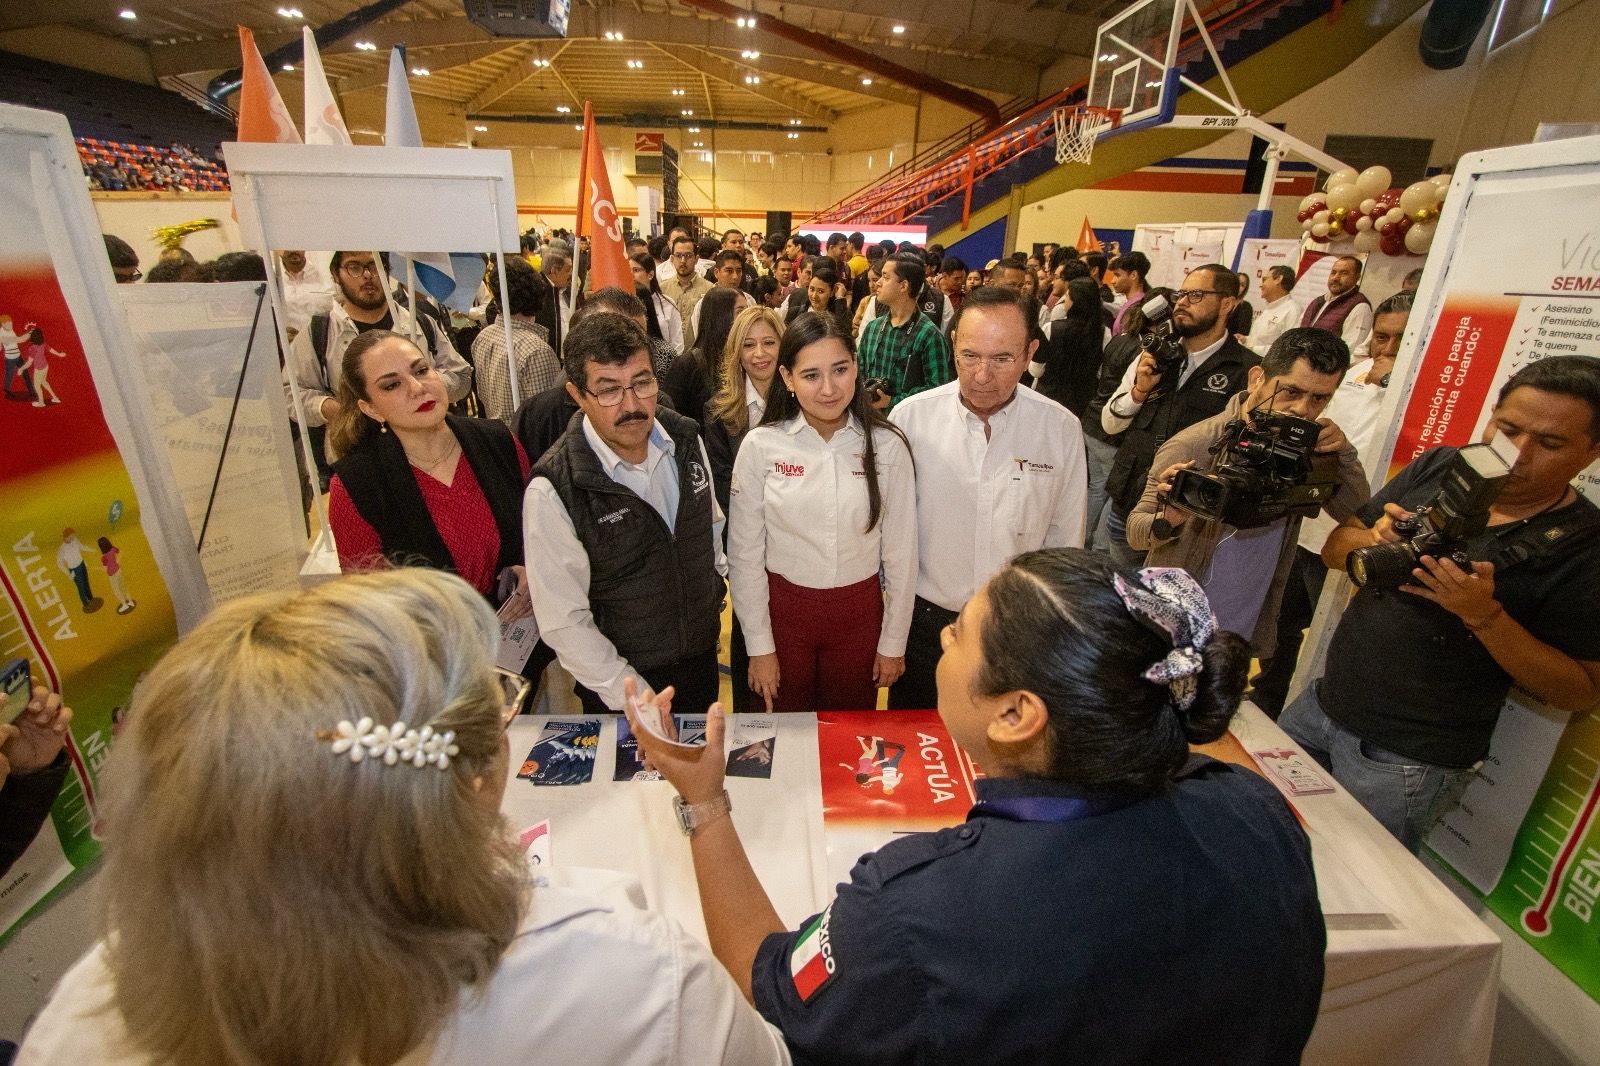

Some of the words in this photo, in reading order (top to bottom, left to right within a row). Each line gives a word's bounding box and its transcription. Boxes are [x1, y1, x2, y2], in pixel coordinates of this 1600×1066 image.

[1202, 118, 1218, 126] BPI
[1218, 118, 1239, 126] 3000
[1544, 304, 1592, 315] Asesinato
[1537, 327, 1547, 336] Te
[1549, 330, 1593, 341] amenaza
[1533, 339, 1543, 348] Te
[1545, 341, 1578, 352] quema
[1529, 351, 1541, 360] De
[1411, 446, 1425, 460] Tu
[1420, 387, 1447, 442] relación
[1440, 365, 1454, 384] de
[1448, 316, 1472, 362] pareja
[1432, 390, 1461, 444] violenta
[1454, 327, 1482, 387] cuando:
[12, 531, 78, 641] ALERTA
[917, 732, 959, 804] ACTÚA
